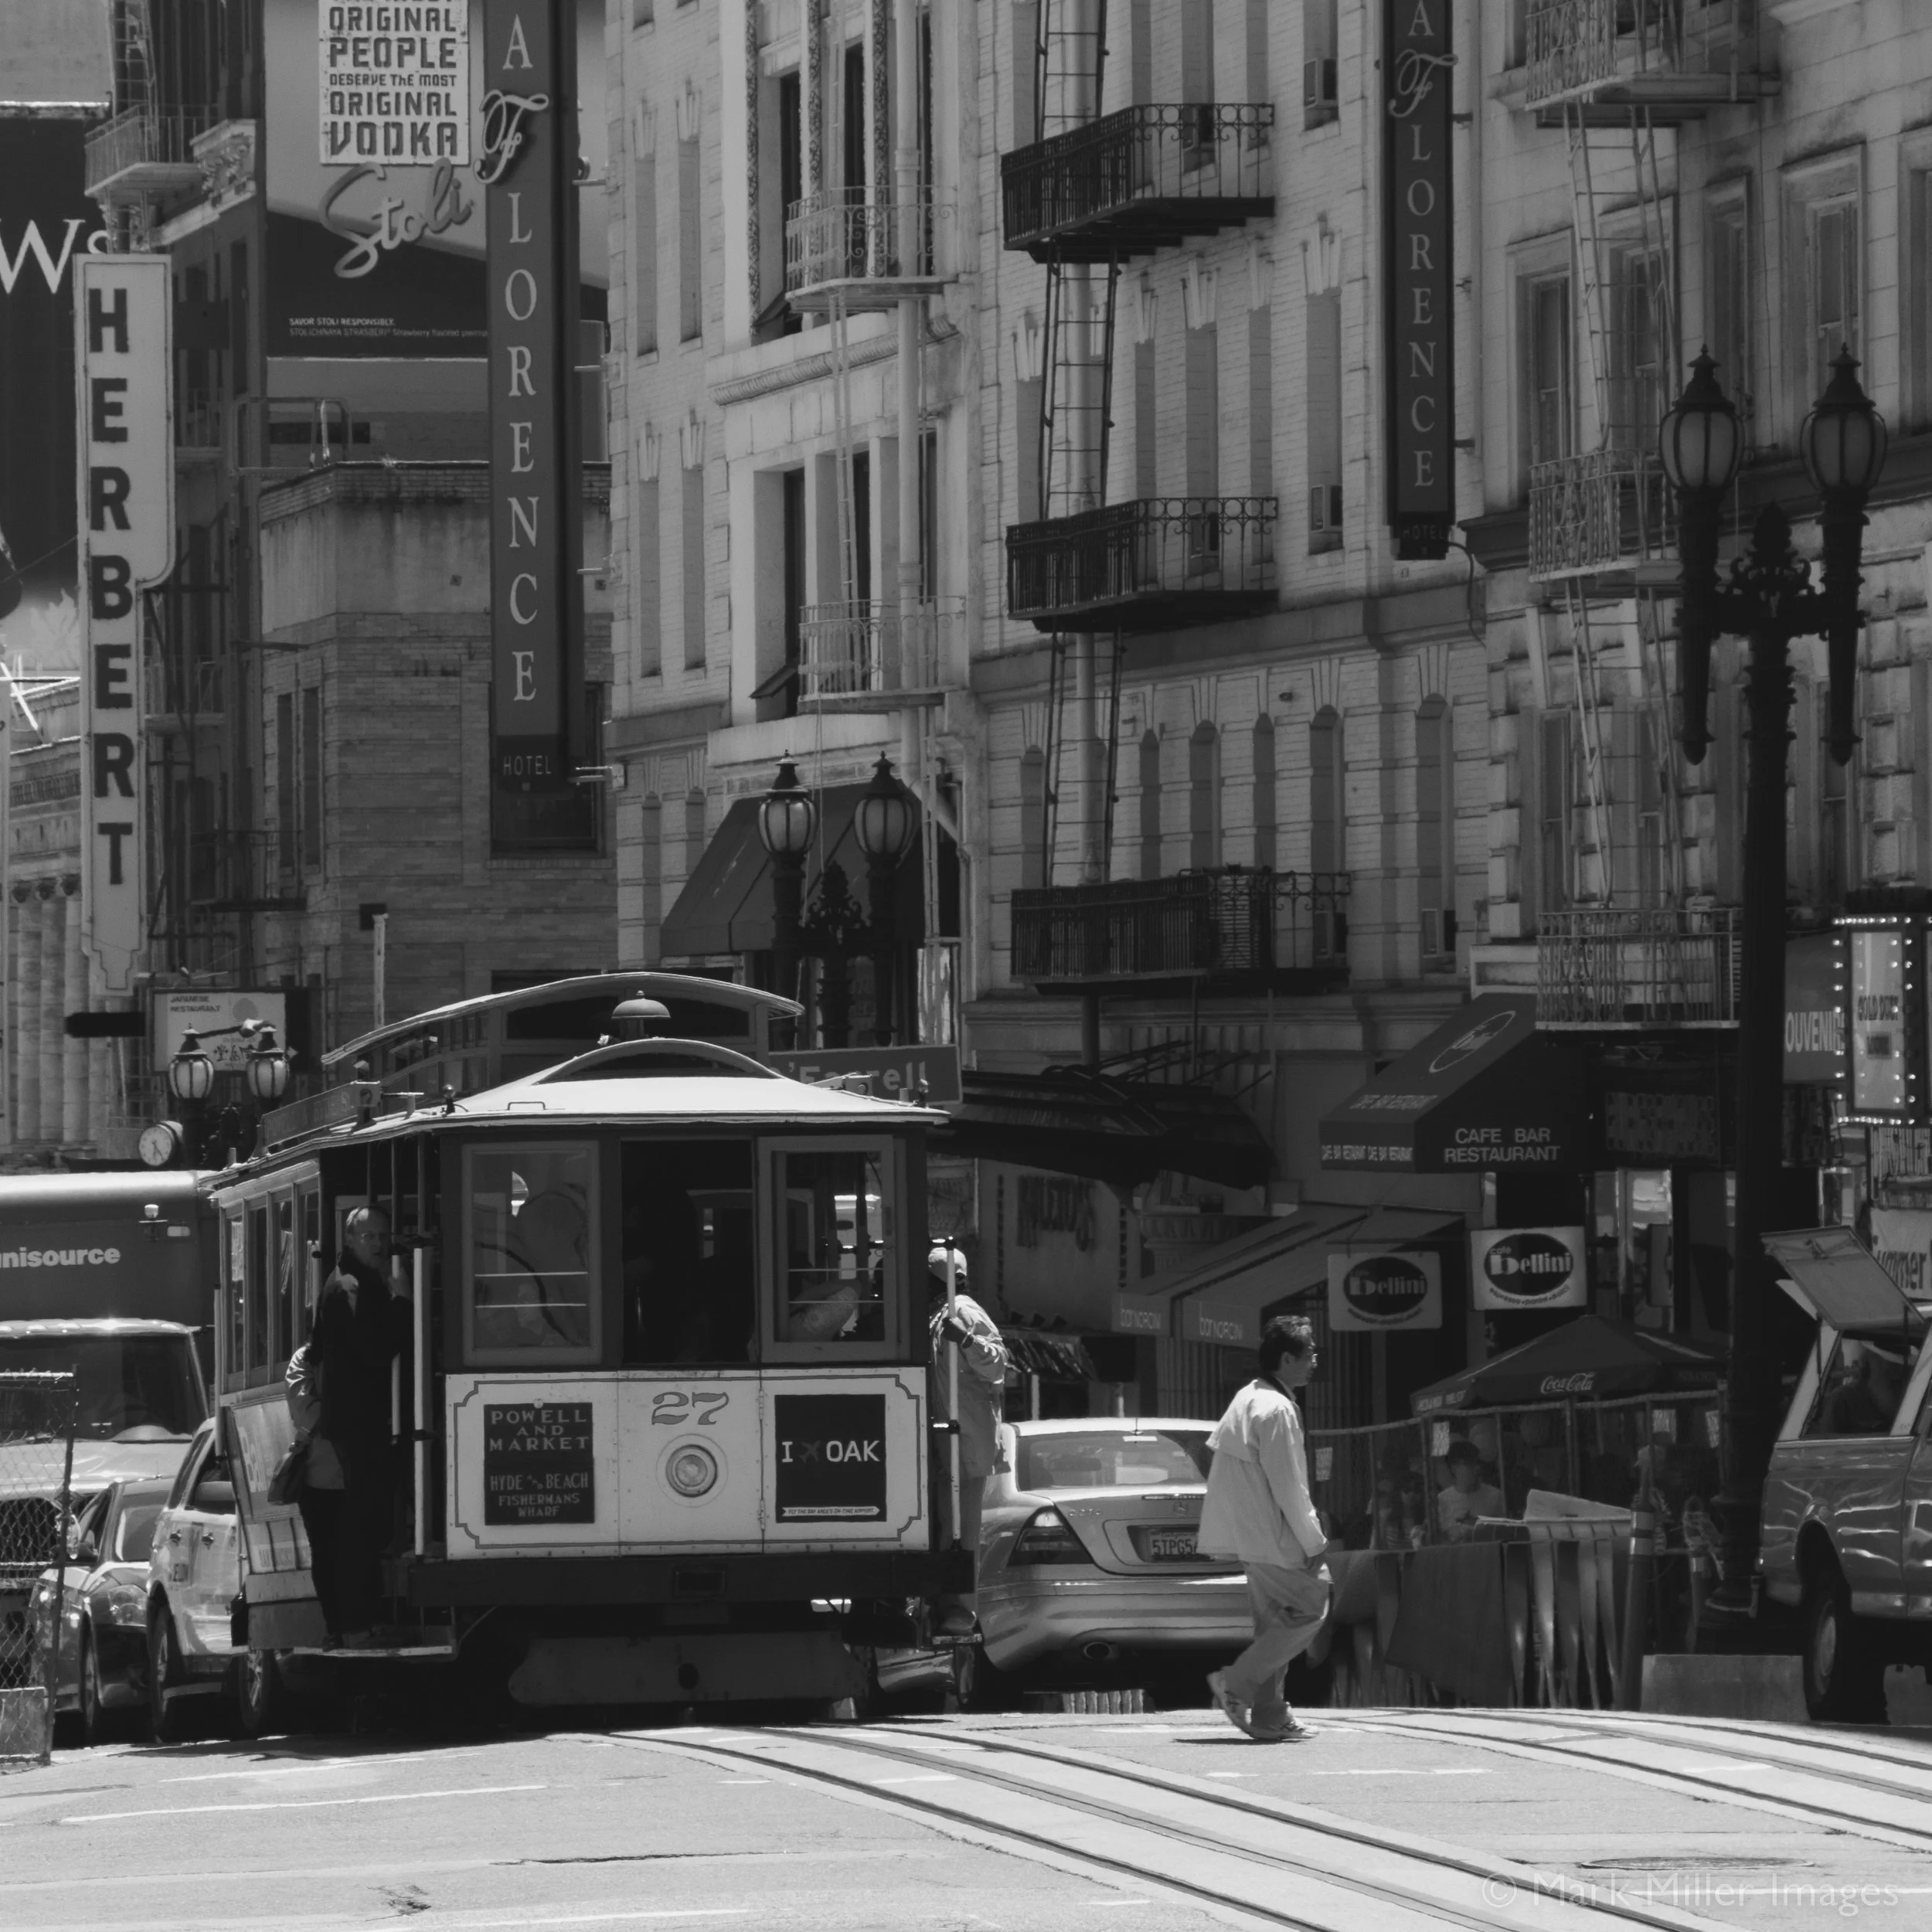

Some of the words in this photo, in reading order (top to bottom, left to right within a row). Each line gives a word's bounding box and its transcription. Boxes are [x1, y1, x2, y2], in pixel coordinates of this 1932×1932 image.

[329, 7, 457, 32] ORIGINAL
[1410, 0, 1433, 36] A
[329, 38, 457, 68] PEOPLE
[502, 15, 532, 70] A
[330, 74, 386, 86] DESERVE
[329, 92, 457, 117] ORIGINAL
[329, 121, 457, 156] VODKA
[319, 158, 474, 279] Stoli
[1389, 49, 1459, 488] FLORENCE
[473, 89, 549, 702] FLORENCE
[89, 288, 134, 885] HERBERT
[503, 756, 552, 776] HOTEL
[1785, 1012, 1845, 1053] OUVENIR
[1456, 1128, 1502, 1144] CAFE
[1515, 1128, 1551, 1143] BAR
[1444, 1146, 1560, 1163] RESTAURANT
[0, 1247, 121, 1268] nisource
[1490, 1252, 1572, 1275] bellini
[1349, 1276, 1426, 1295] bellini
[491, 1409, 587, 1425] POWELL
[652, 1393, 730, 1426] 27
[516, 1425, 564, 1436] AND
[488, 1437, 590, 1451] MARKET
[781, 1440, 794, 1463] I
[825, 1440, 881, 1463] OAK
[491, 1475, 523, 1491] HYDE
[546, 1471, 589, 1489] BEACH
[498, 1492, 580, 1506] FISHERMANS
[518, 1505, 560, 1518] WHARF
